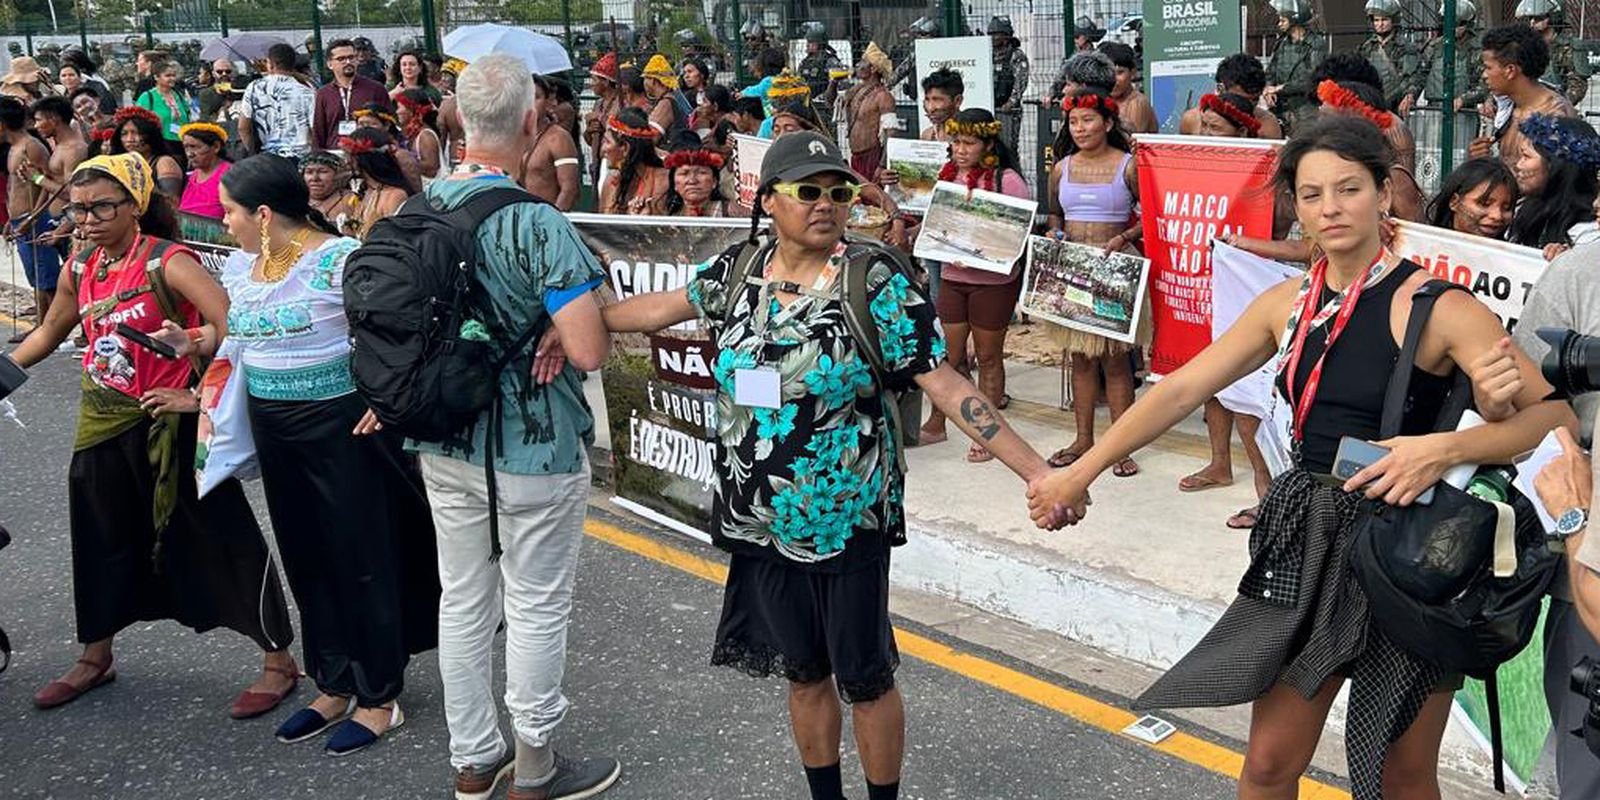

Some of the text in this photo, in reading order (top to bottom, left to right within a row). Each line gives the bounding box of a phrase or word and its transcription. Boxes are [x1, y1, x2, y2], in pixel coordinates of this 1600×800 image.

[1162, 1, 1219, 19] BRASIL
[1163, 192, 1229, 220] MARCO
[1472, 271, 1511, 300] AO
[658, 346, 715, 377] NÃ
[647, 381, 717, 430] É PROGR
[630, 409, 640, 460] É
